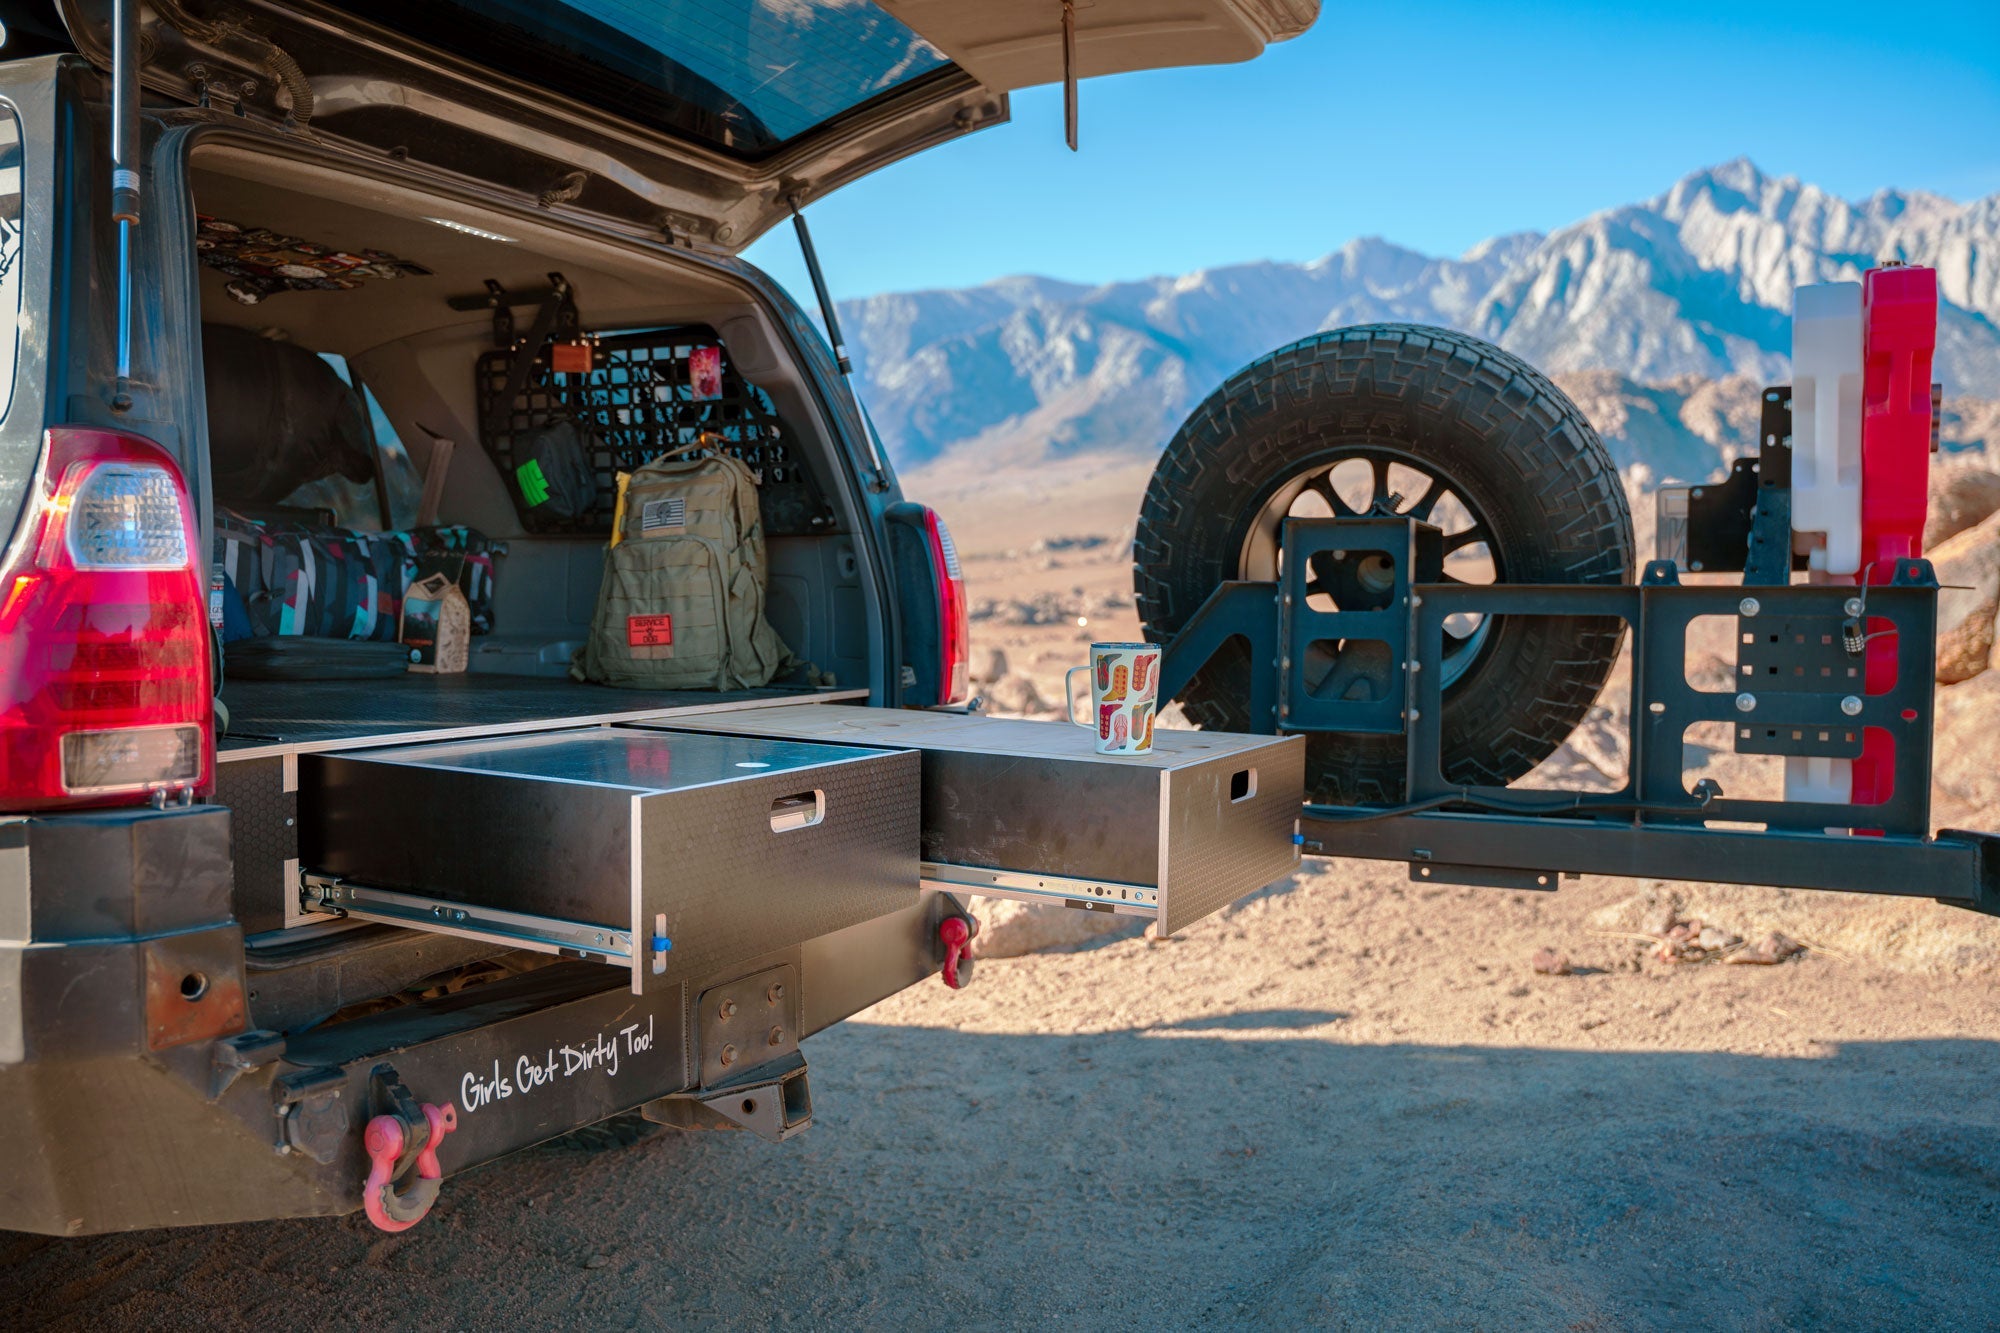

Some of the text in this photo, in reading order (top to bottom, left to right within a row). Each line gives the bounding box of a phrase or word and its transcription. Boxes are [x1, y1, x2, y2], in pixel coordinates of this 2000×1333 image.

[1225, 410, 1408, 484] COOPER
[634, 618, 665, 627] SERVICE
[643, 635, 658, 643] DOG
[461, 1014, 654, 1112] Girls Get Dirty Too!
